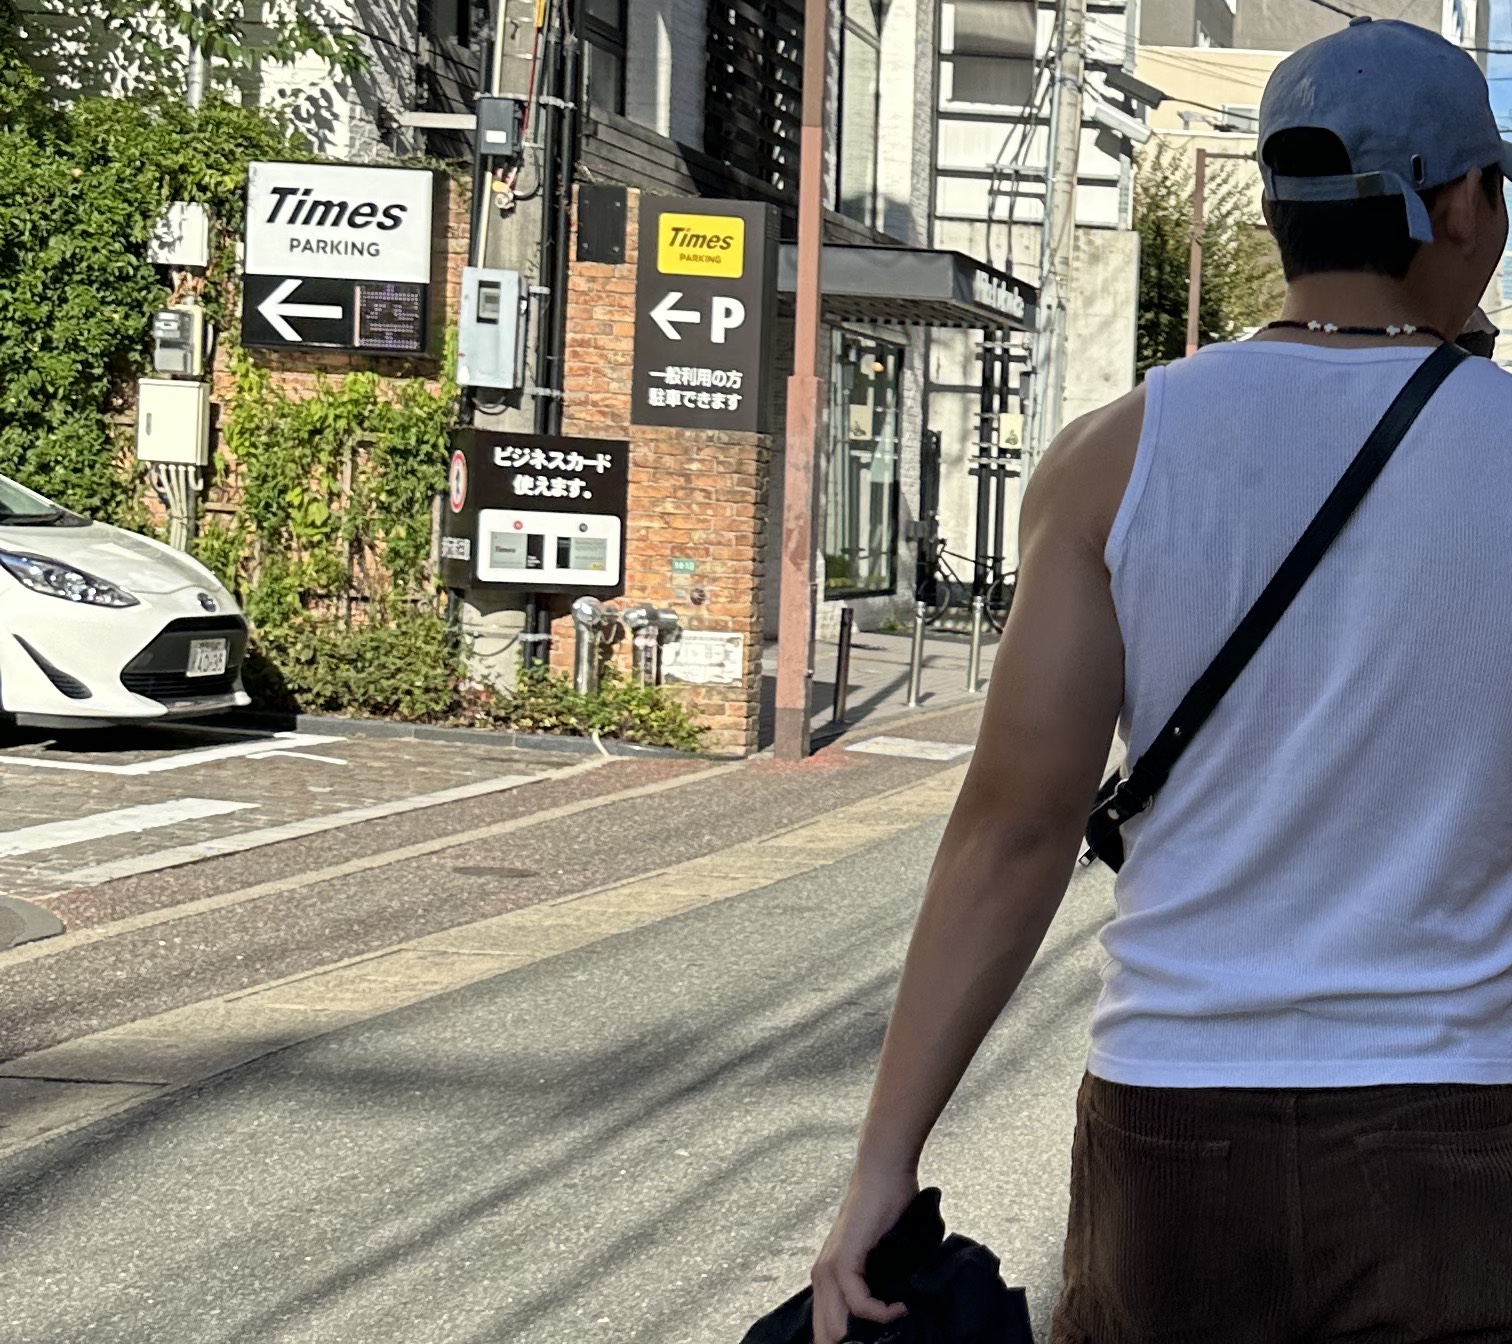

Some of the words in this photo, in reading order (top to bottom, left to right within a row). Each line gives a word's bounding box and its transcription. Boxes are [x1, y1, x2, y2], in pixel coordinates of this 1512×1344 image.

[265, 186, 408, 231] Times
[289, 237, 381, 258] PARKING
[668, 226, 735, 251] Times
[678, 252, 722, 265] PARKING
[711, 295, 746, 344] P
[648, 365, 743, 390] 一般利用の方
[647, 387, 743, 411] 駐車できます
[493, 445, 613, 474] ビジネスカード
[512, 473, 593, 500] 使えます。
